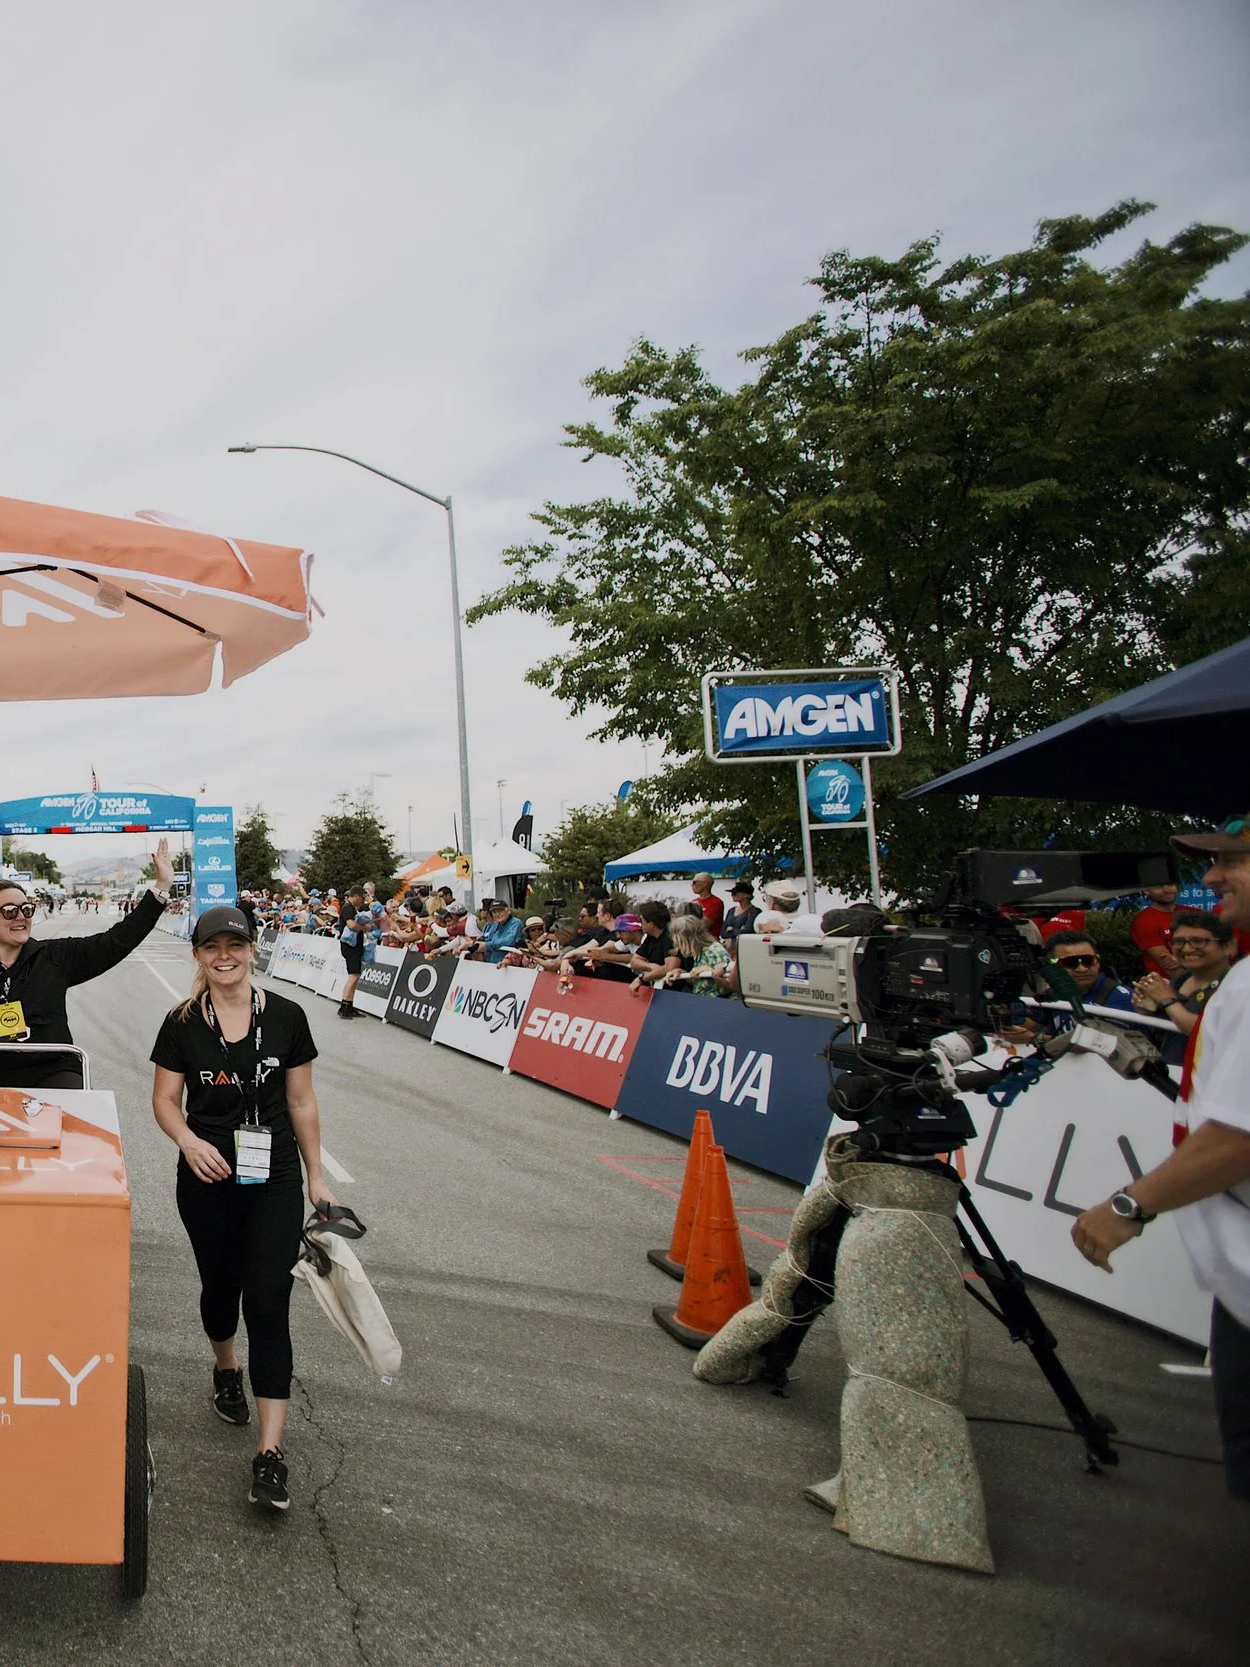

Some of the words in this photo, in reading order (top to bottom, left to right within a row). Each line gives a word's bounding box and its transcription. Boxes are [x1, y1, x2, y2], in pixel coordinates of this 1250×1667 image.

[723, 693, 876, 740] AMGEN
[40, 797, 75, 808] AMGEN
[99, 797, 136, 808] TOUR
[136, 798, 148, 808] of
[99, 807, 152, 816] CALIFORNIA
[75, 825, 101, 833] MORGAN
[101, 824, 118, 832] HILL
[1192, 888, 1203, 897] to
[811, 989, 825, 1000] 100
[392, 995, 436, 1022] OAKLEY
[461, 988, 526, 1033] NBCSN
[523, 1007, 628, 1061] SRAM
[665, 1035, 773, 1114] BBVA
